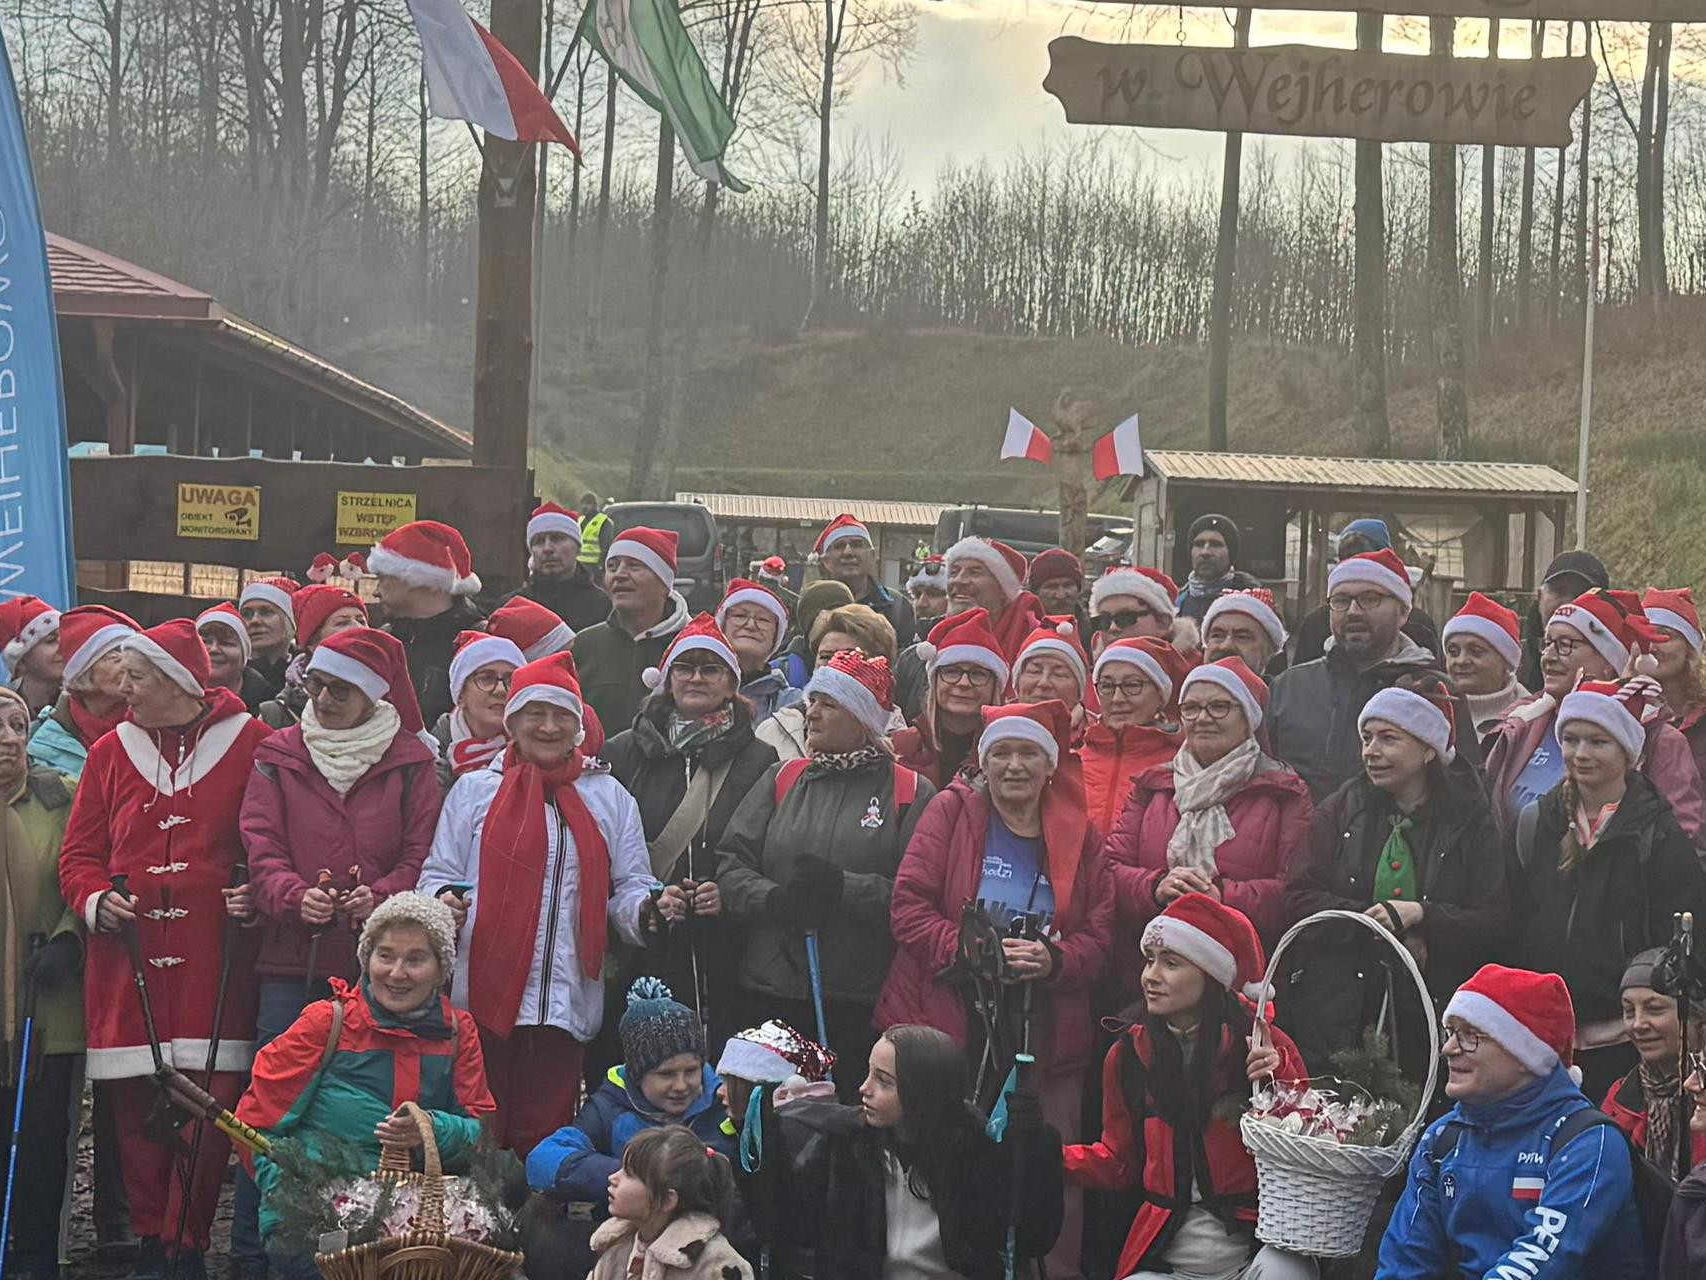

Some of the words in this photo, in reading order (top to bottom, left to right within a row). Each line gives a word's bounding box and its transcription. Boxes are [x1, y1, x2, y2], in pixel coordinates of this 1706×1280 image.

[1174, 49, 1538, 127] Wejherowie
[181, 487, 256, 506] UWAGA
[341, 496, 413, 508] STRZELNICA
[180, 513, 213, 521] OBIEKT
[356, 513, 397, 526] WSTĘP
[180, 525, 253, 535] MONITOROWANY
